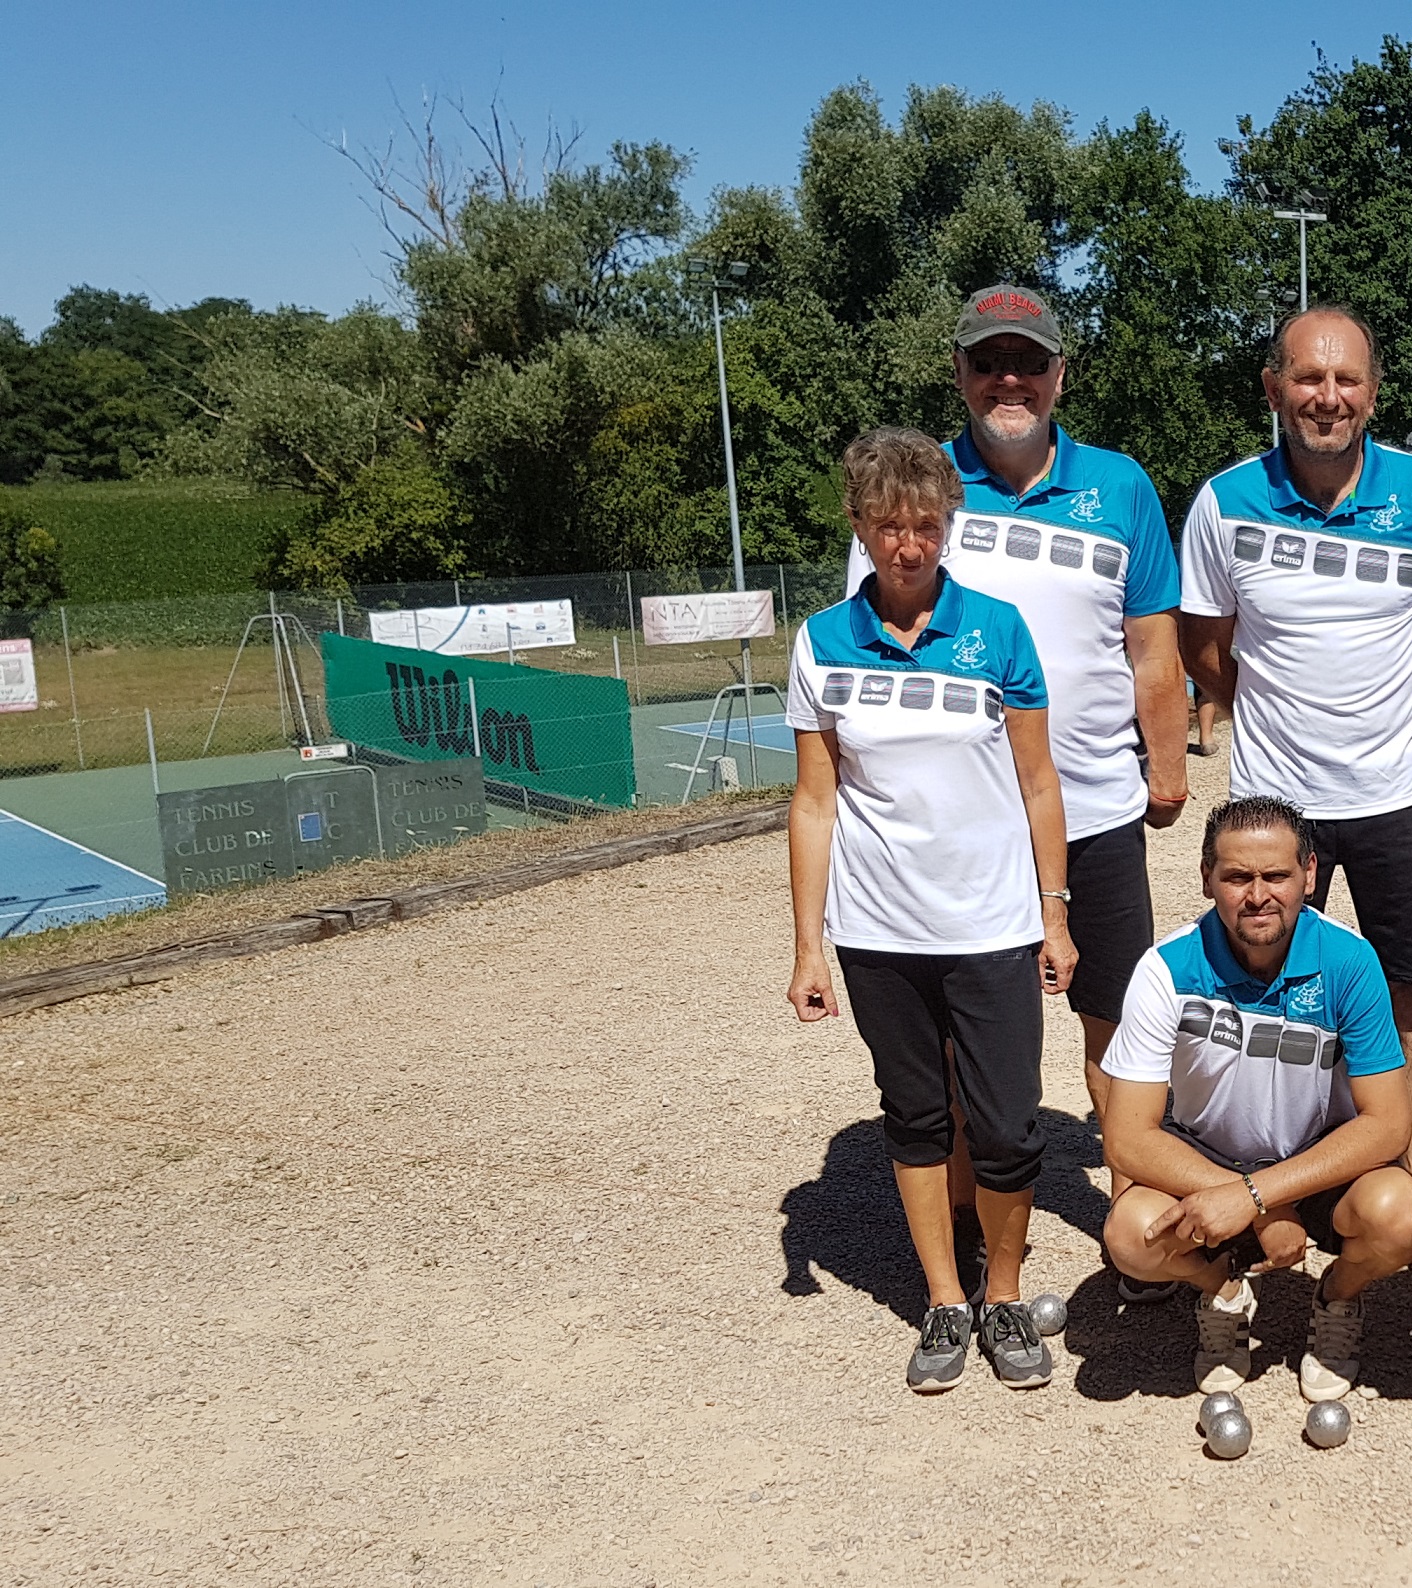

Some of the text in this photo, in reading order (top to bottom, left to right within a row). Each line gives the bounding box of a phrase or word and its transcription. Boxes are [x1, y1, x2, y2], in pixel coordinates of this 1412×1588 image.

[976, 292, 1005, 315] MIAMI
[1009, 292, 1042, 317] BEACH
[963, 537, 994, 548] erima
[1272, 553, 1302, 566] erima
[650, 602, 698, 622] NTA
[174, 799, 256, 825] TENNIS
[391, 801, 482, 828] CLUB DE
[174, 828, 274, 858] CLUB DE
[179, 860, 277, 889] FAREINS
[1213, 1029, 1242, 1045] erima
